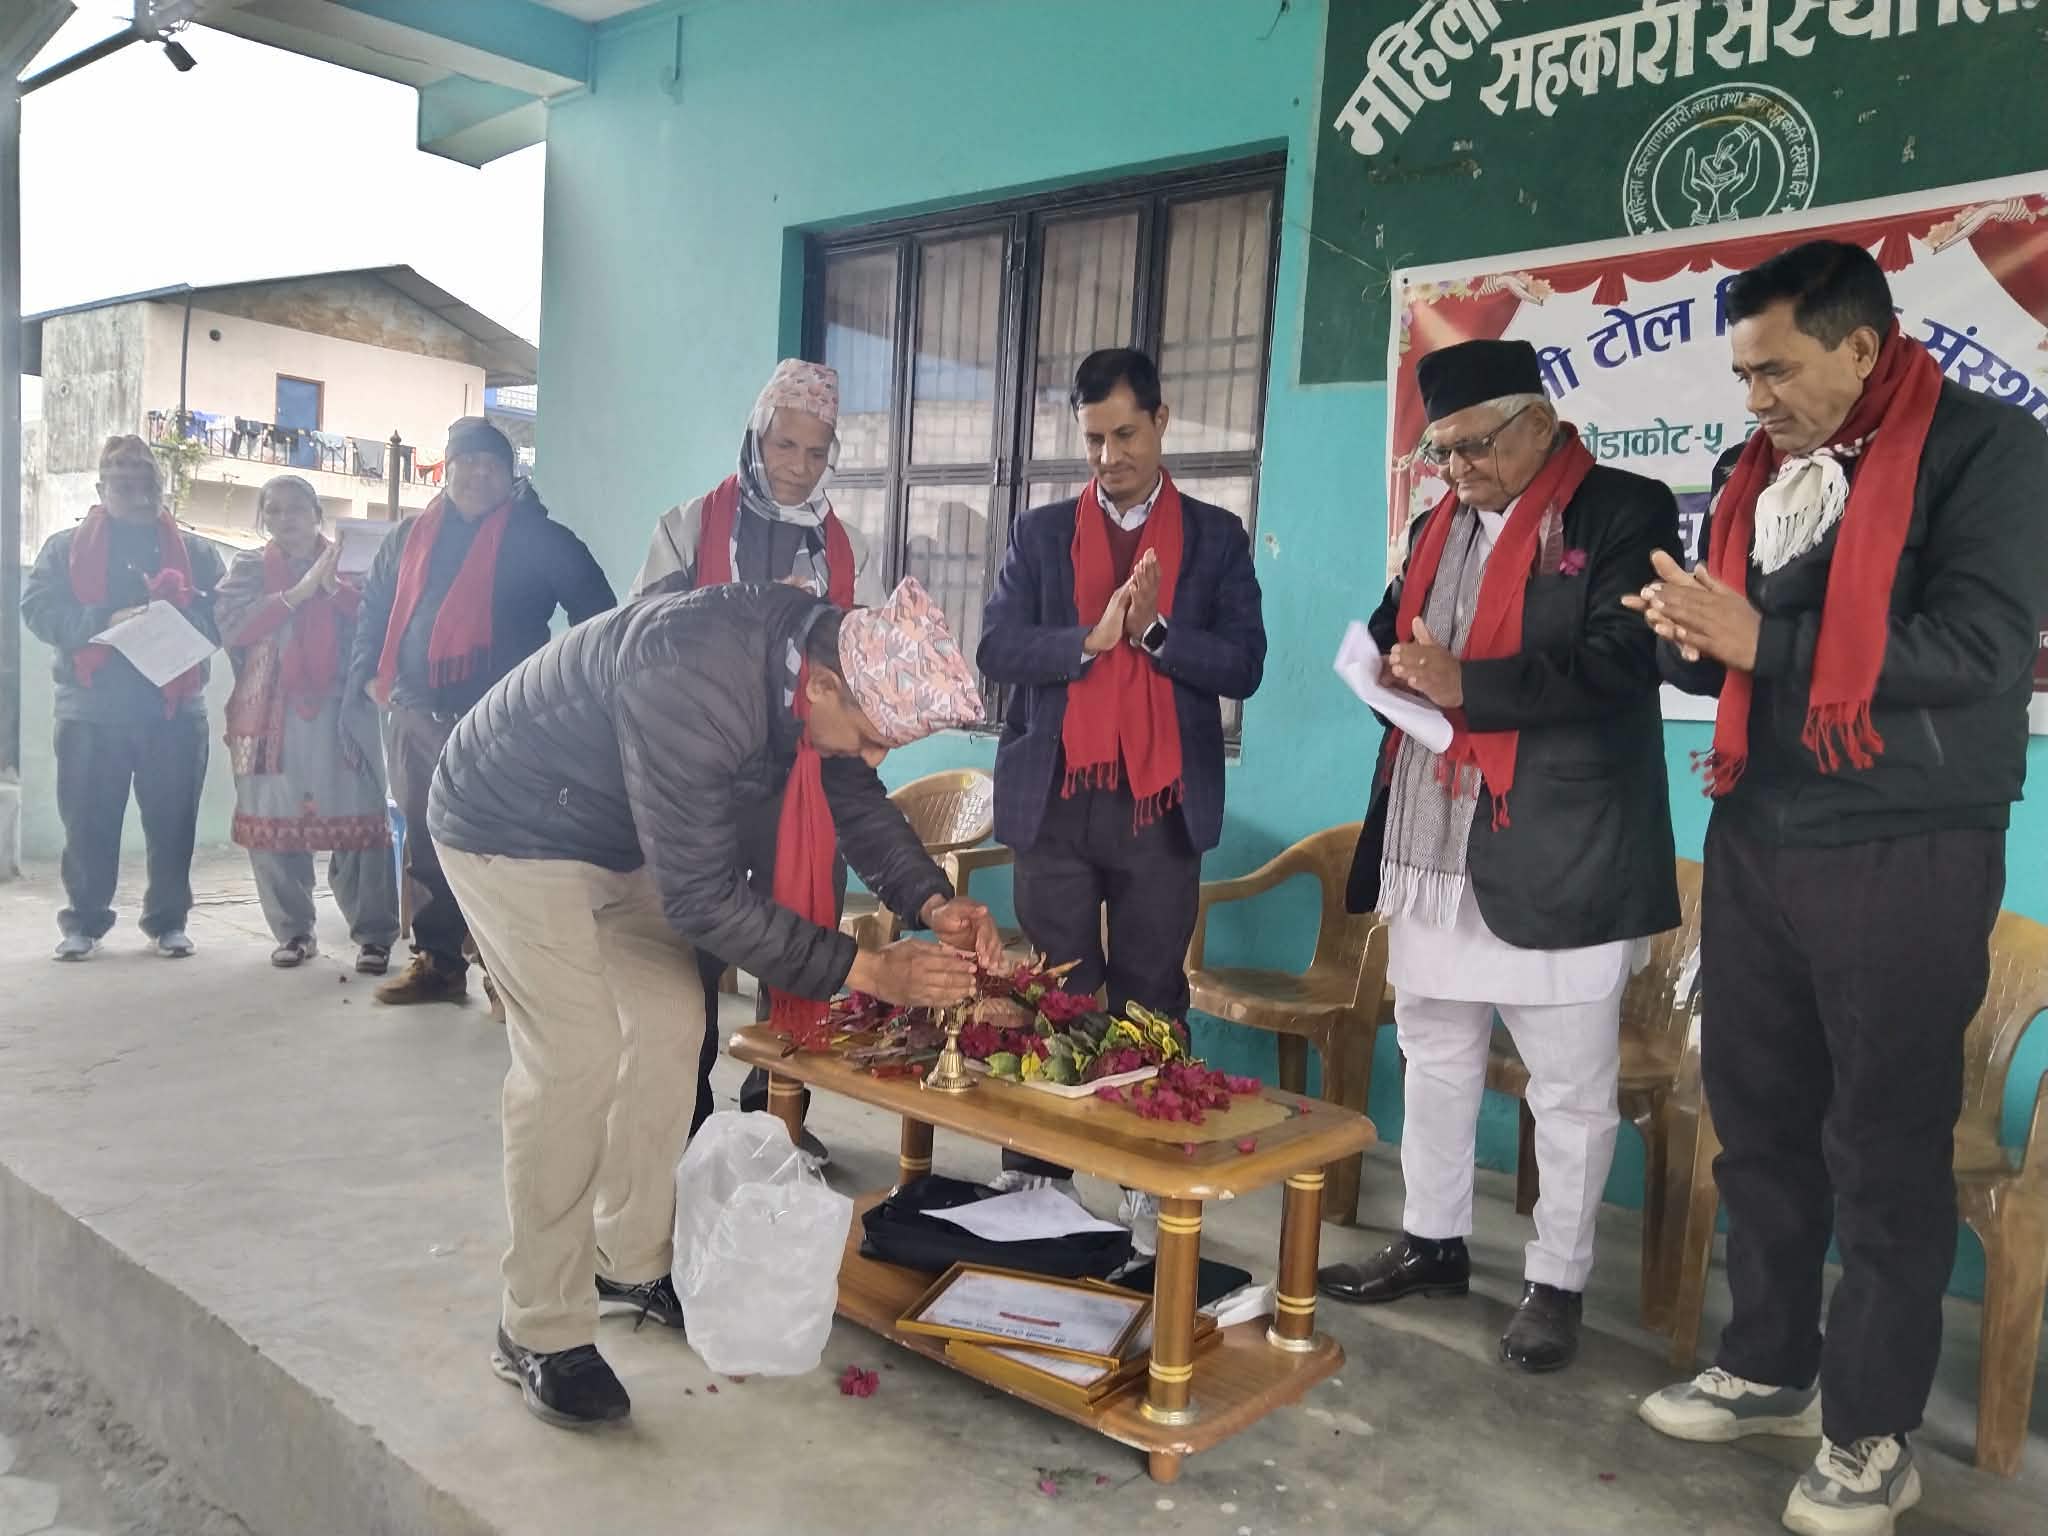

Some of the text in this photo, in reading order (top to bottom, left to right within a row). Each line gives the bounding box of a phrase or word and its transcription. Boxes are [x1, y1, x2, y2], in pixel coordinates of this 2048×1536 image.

[1333, 0, 1502, 156] महिला
[1480, 0, 1918, 117] सहकारी सस्था
[1627, 178, 1648, 225] महिला
[1586, 298, 1696, 369] टोल
[1922, 317, 2048, 420] संस्थ
